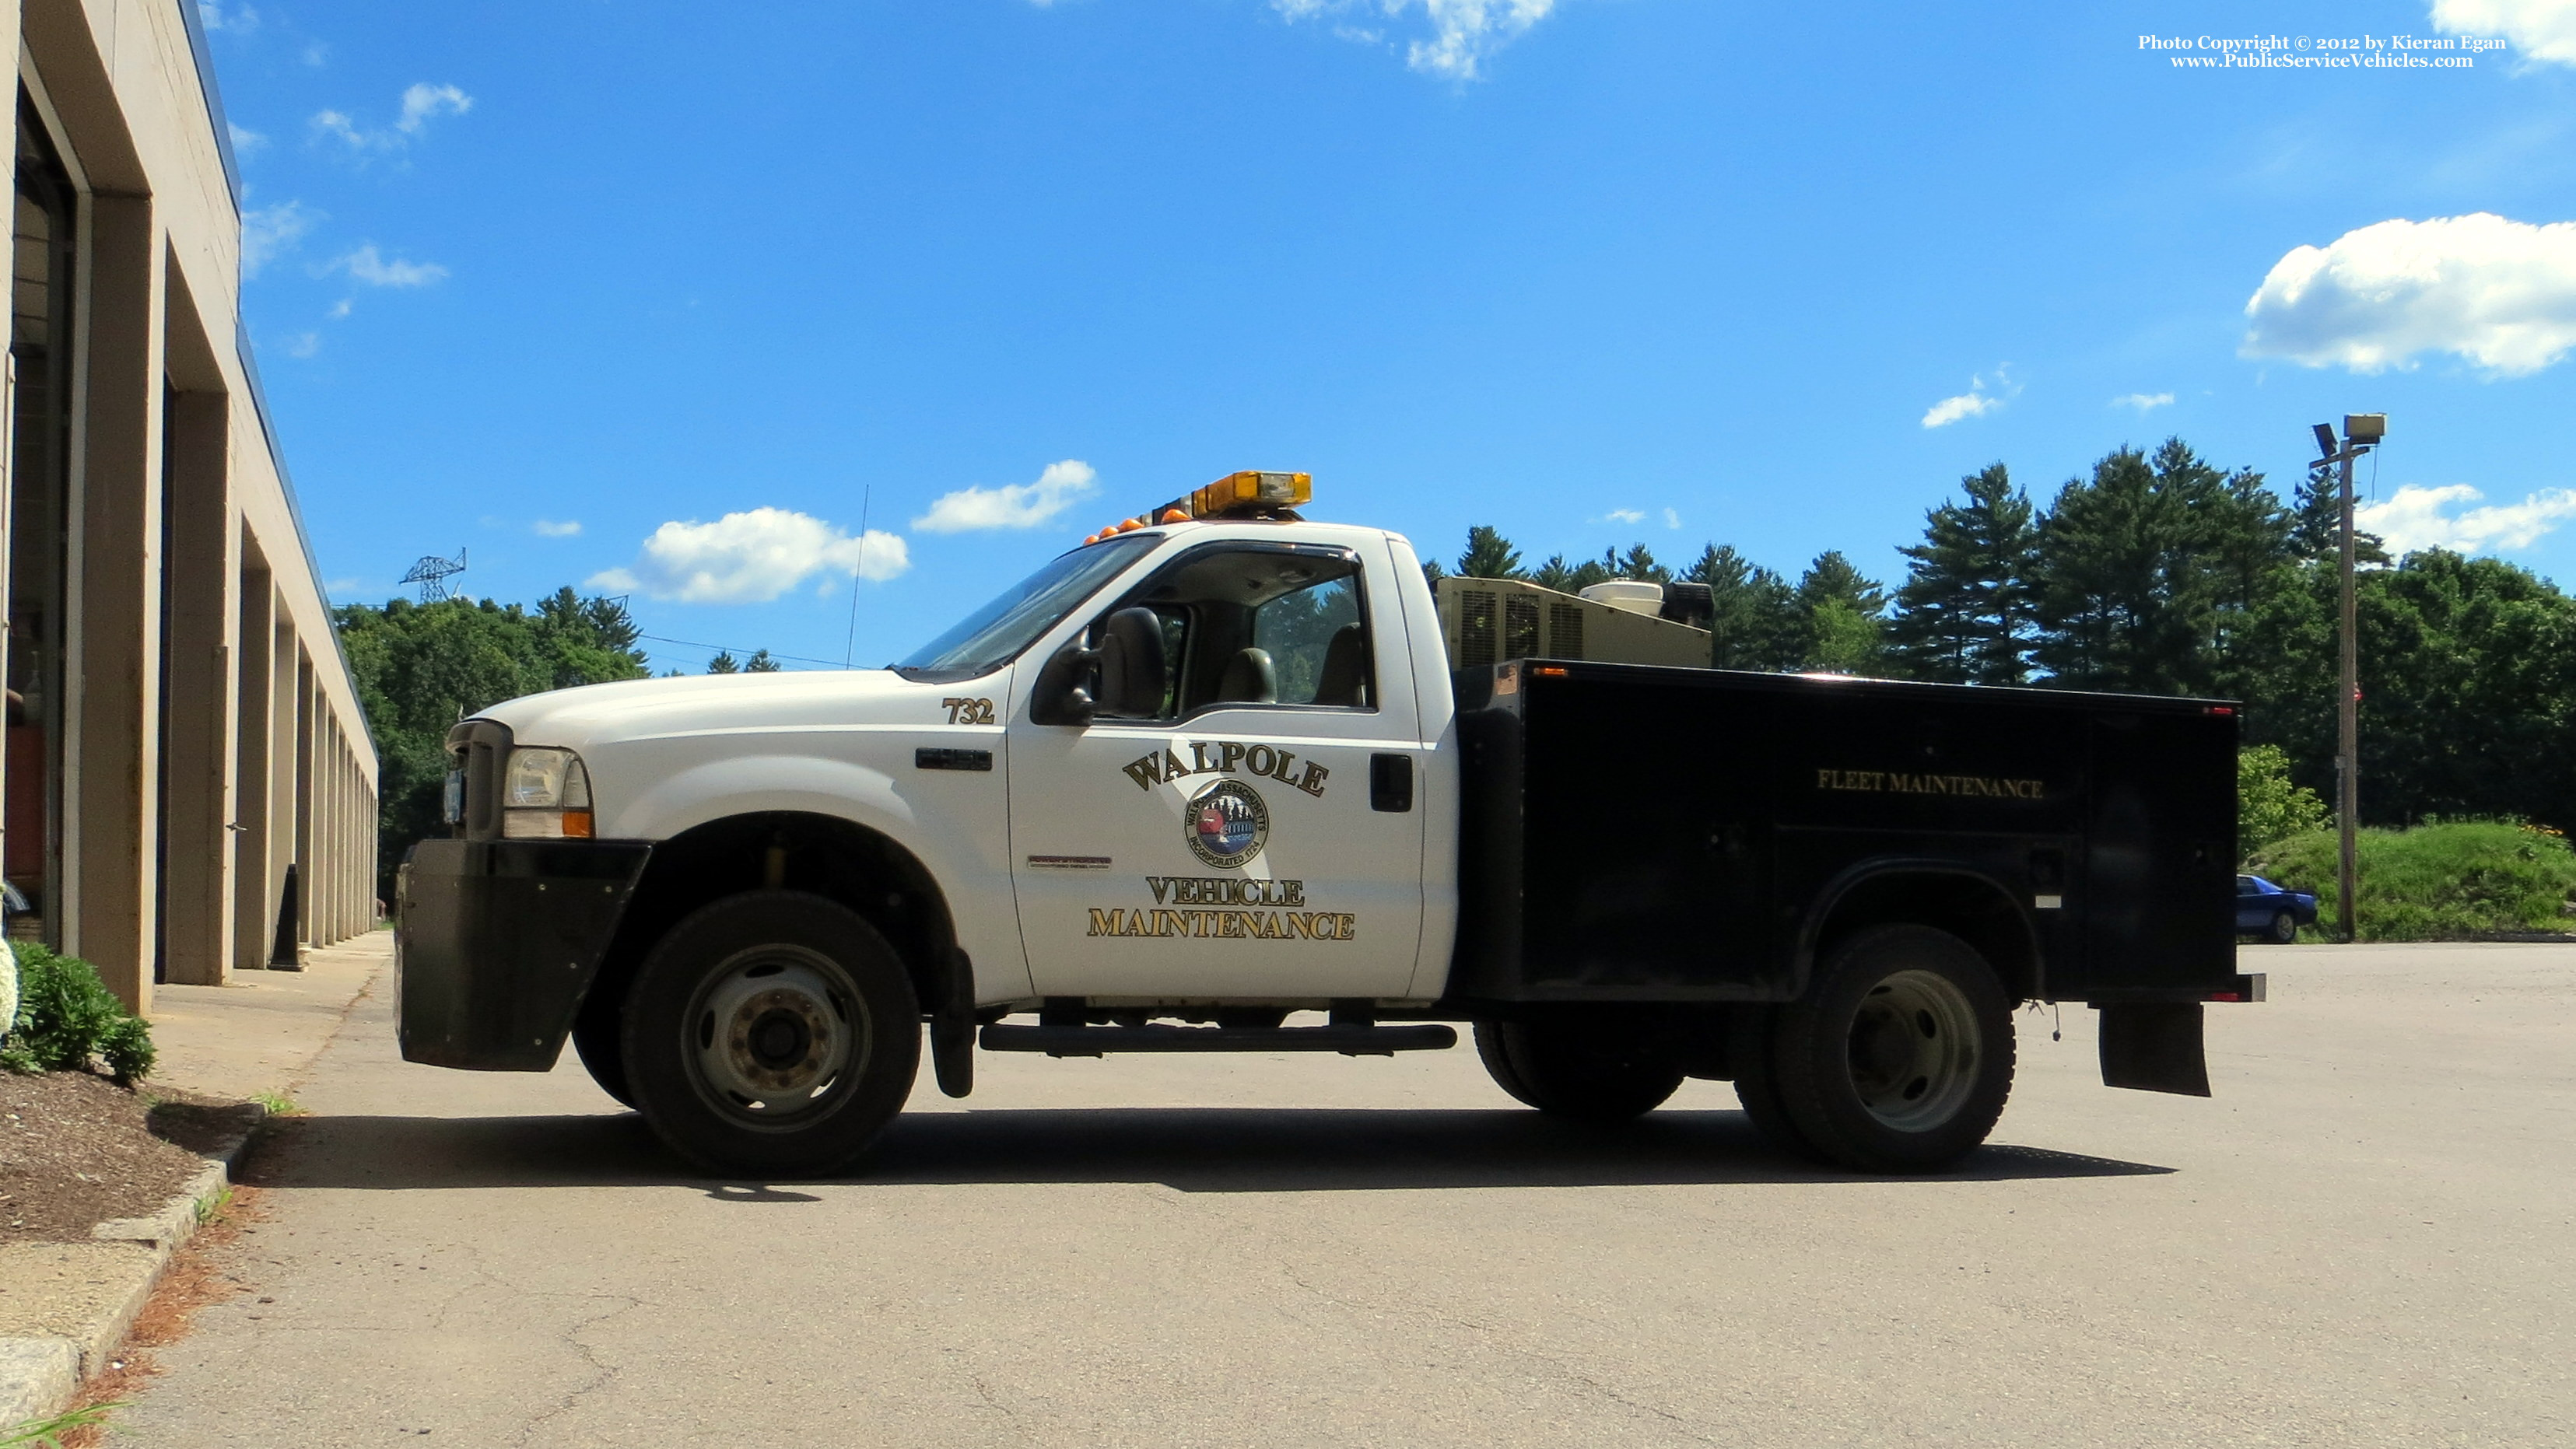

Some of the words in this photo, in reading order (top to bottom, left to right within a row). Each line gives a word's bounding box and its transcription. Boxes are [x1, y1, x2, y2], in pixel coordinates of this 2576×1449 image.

[942, 698, 994, 724] 732
[1123, 741, 1329, 798] WALPOLE
[1817, 769, 1885, 793] FLEET
[1889, 772, 2044, 799] MAINTENANCE
[1216, 783, 1267, 831] ASSACHUSETTS
[1190, 836, 1244, 866] INCORPORATED
[1245, 841, 1260, 858] 1724
[1146, 876, 1306, 907] VEHICLE
[1087, 908, 1355, 941] MAINTENANCE
